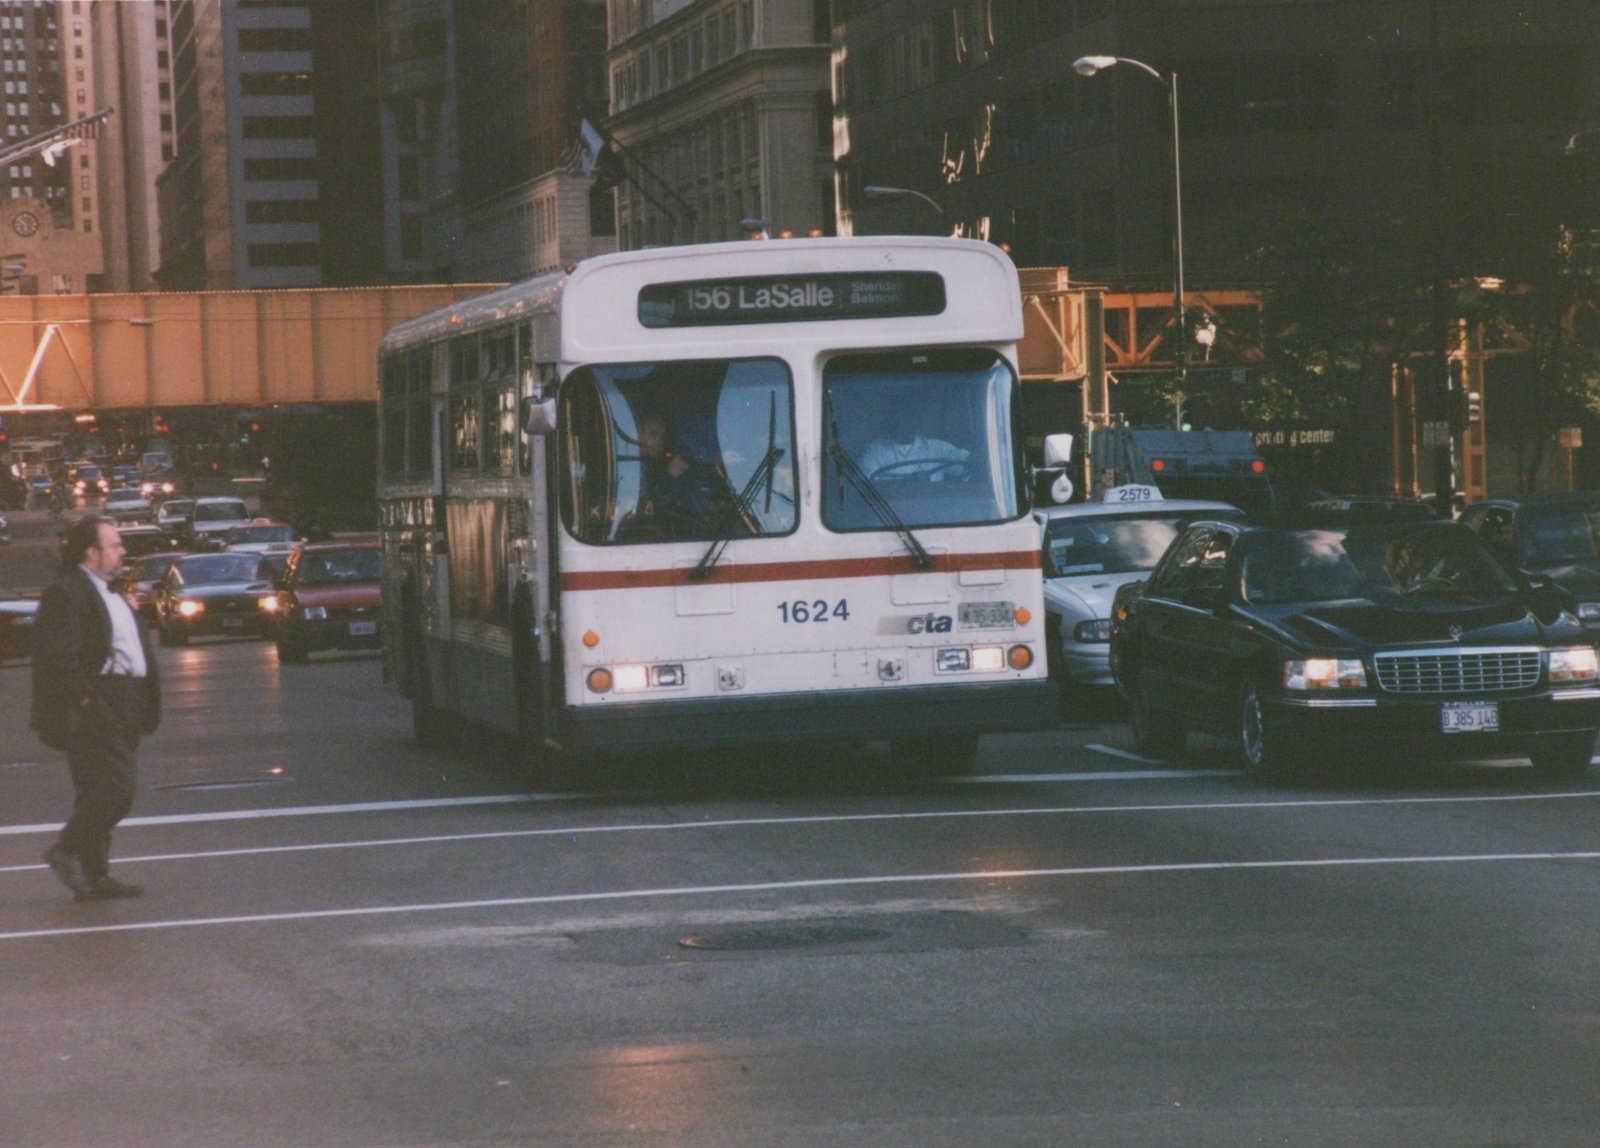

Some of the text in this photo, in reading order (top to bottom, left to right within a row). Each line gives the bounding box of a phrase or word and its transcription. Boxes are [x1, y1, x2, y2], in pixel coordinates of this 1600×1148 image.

[688, 283, 834, 310] 156 LaSalle
[1255, 431, 1297, 447] pritig
[1300, 429, 1335, 444] center
[1119, 488, 1150, 501] 2579
[777, 599, 850, 623] 1624
[907, 612, 953, 634] cta
